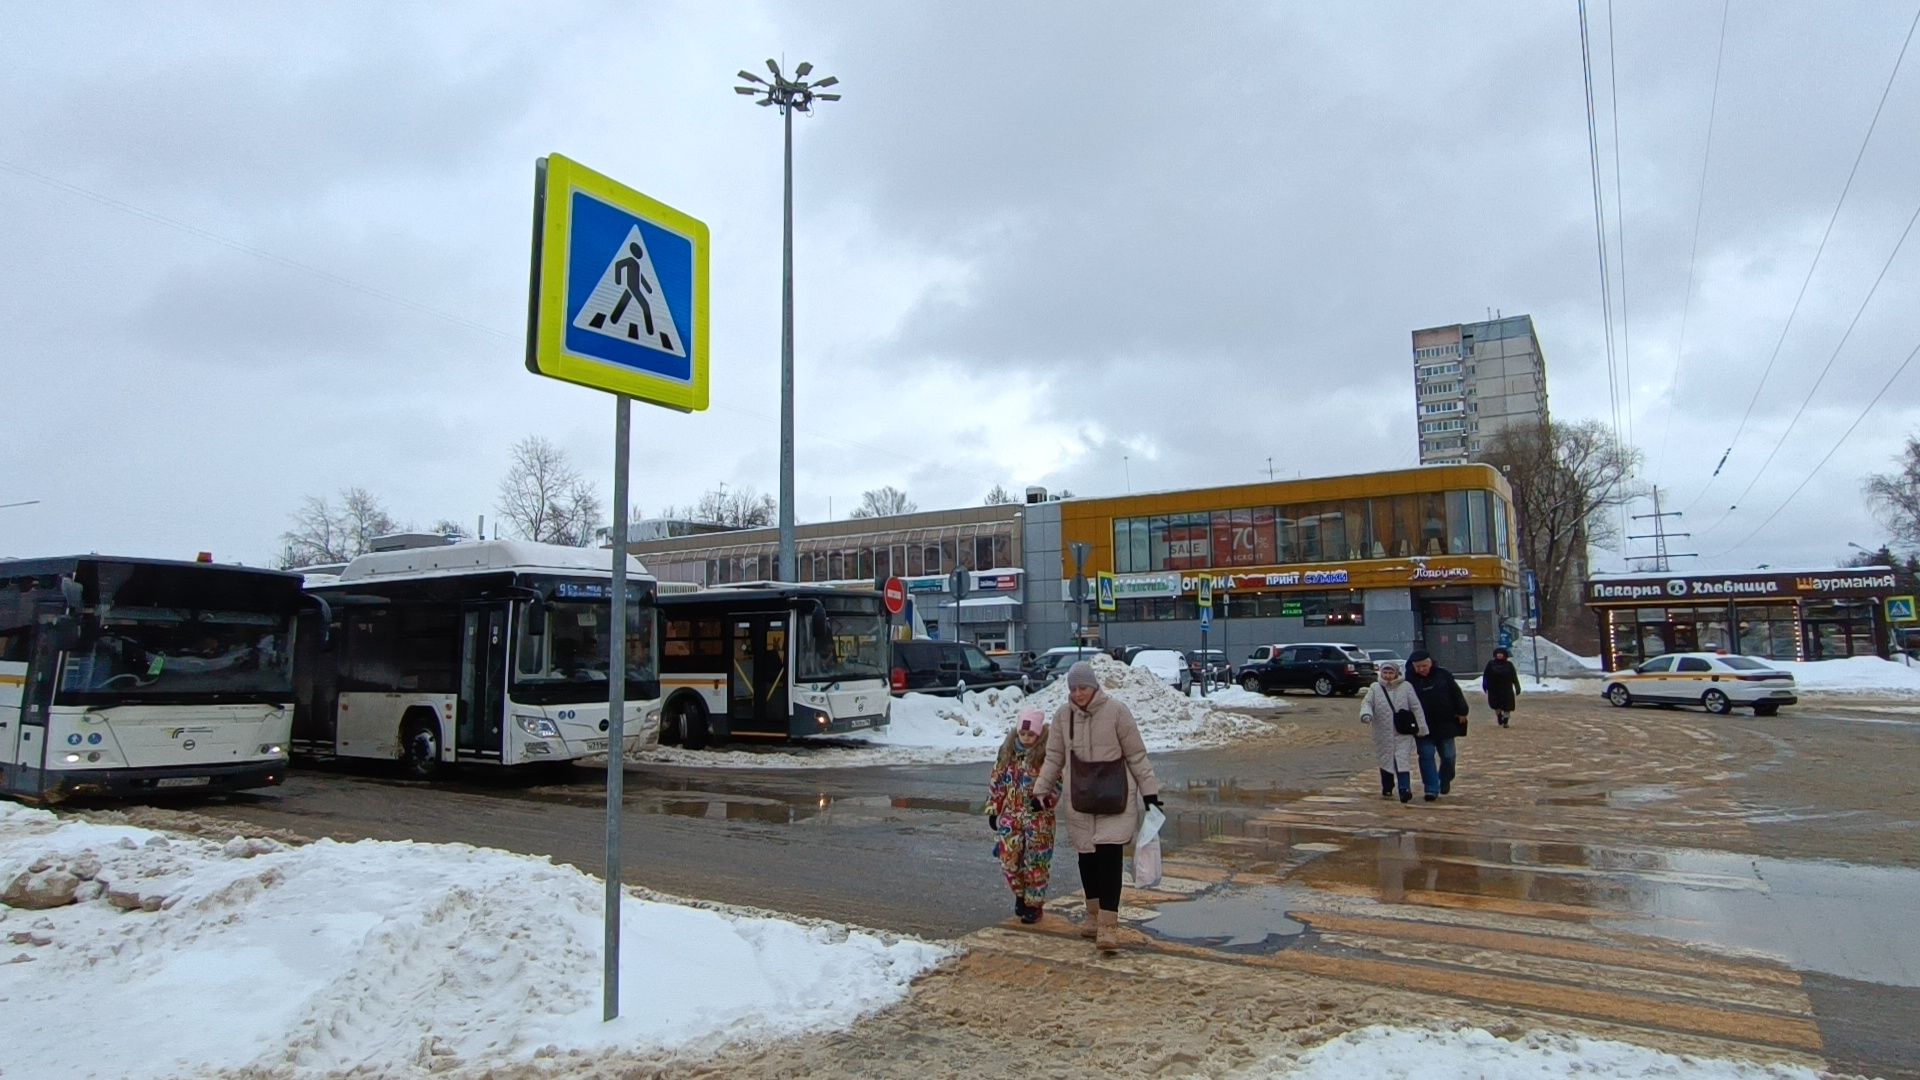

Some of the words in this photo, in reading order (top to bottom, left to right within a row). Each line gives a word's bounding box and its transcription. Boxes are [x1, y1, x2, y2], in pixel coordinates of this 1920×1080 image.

[1171, 542, 1201, 556] SALE
[1265, 573, 1300, 586] ПРИНТ
[1304, 571, 1348, 585] СУМКИ
[1412, 566, 1469, 579] Подружка
[559, 583, 566, 597] 9
[1182, 576, 1236, 591] ОПИКА
[1593, 583, 1662, 599] Пекарня
[1692, 580, 1779, 594] Хлебница
[1795, 574, 1896, 592] Шаурмания
